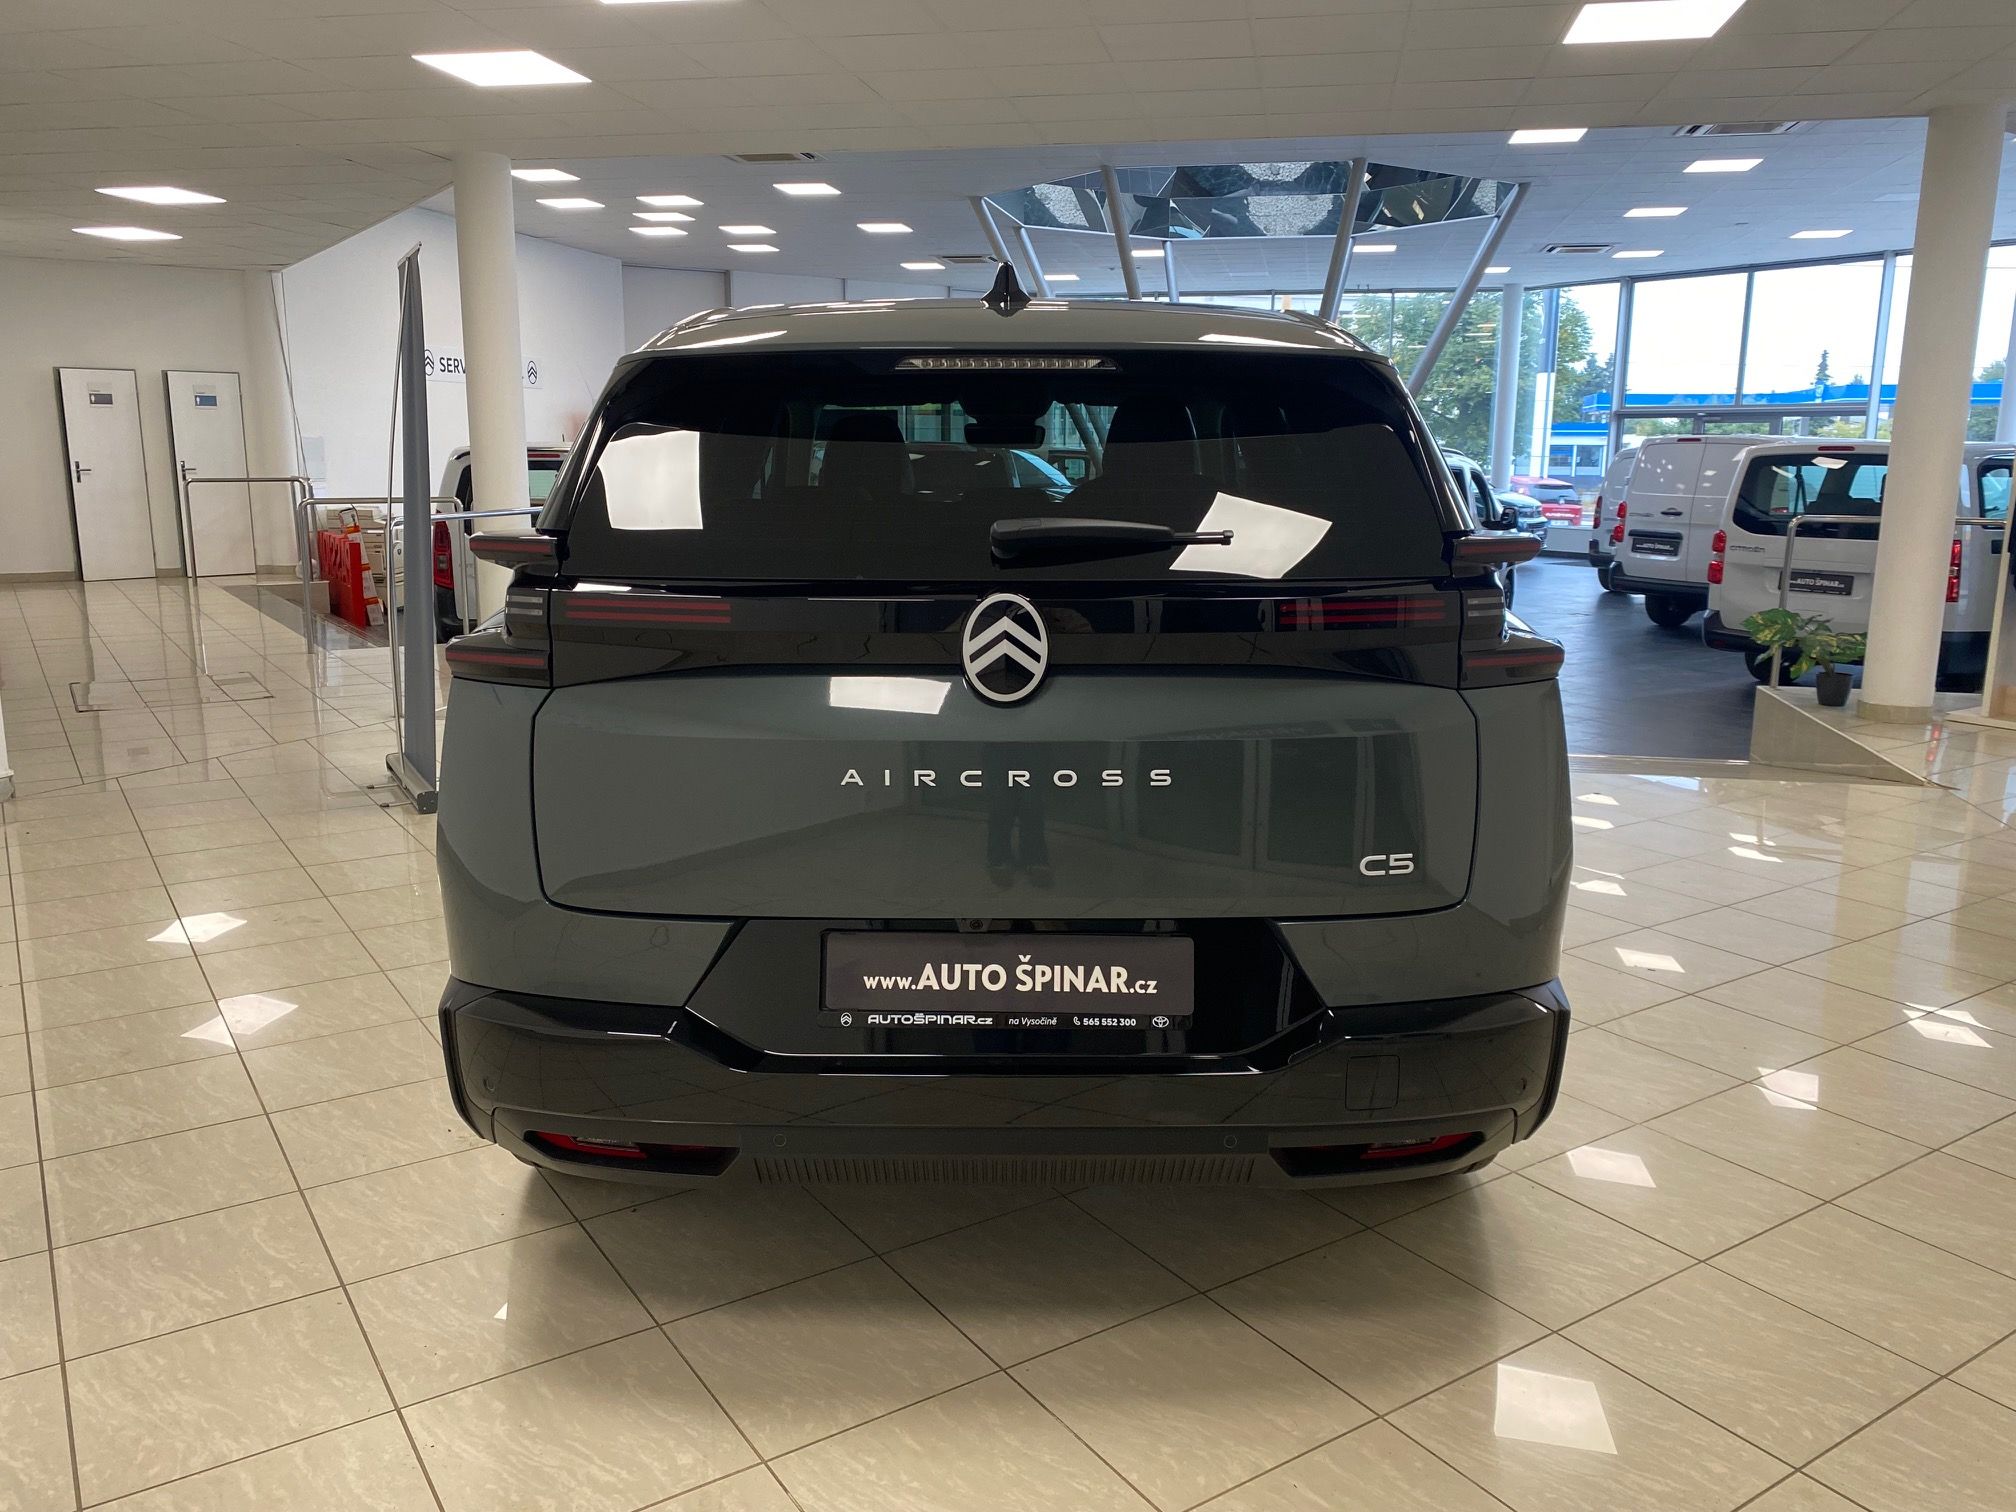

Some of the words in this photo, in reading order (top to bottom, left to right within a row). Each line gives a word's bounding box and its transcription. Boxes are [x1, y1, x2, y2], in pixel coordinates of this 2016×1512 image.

[840, 769, 1172, 787] AIRCROSS
[1360, 853, 1414, 876] C5
[863, 963, 1007, 992] www.AUTO
[1015, 954, 1158, 994] ŠPINAR.cz
[1021, 1016, 1058, 1027] Vysočině
[1083, 1017, 1100, 1026] 565
[1101, 1018, 1118, 1026] 552
[1119, 1018, 1137, 1027] 300
